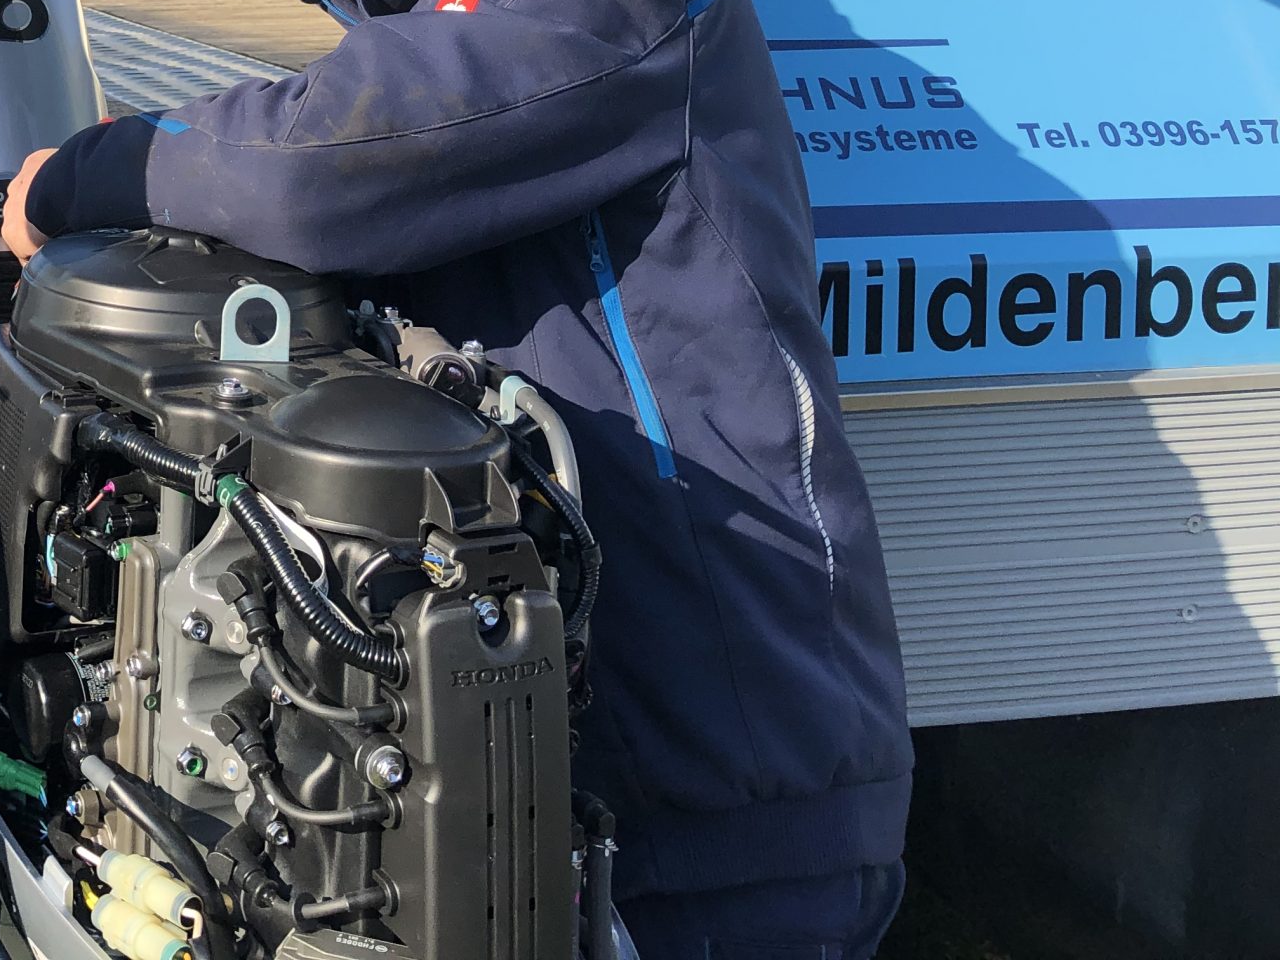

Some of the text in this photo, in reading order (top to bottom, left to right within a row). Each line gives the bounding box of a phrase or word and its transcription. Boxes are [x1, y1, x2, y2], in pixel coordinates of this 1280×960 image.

[1016, 119, 1280, 149] Tel. 03996-157
[450, 656, 556, 688] HONDA
